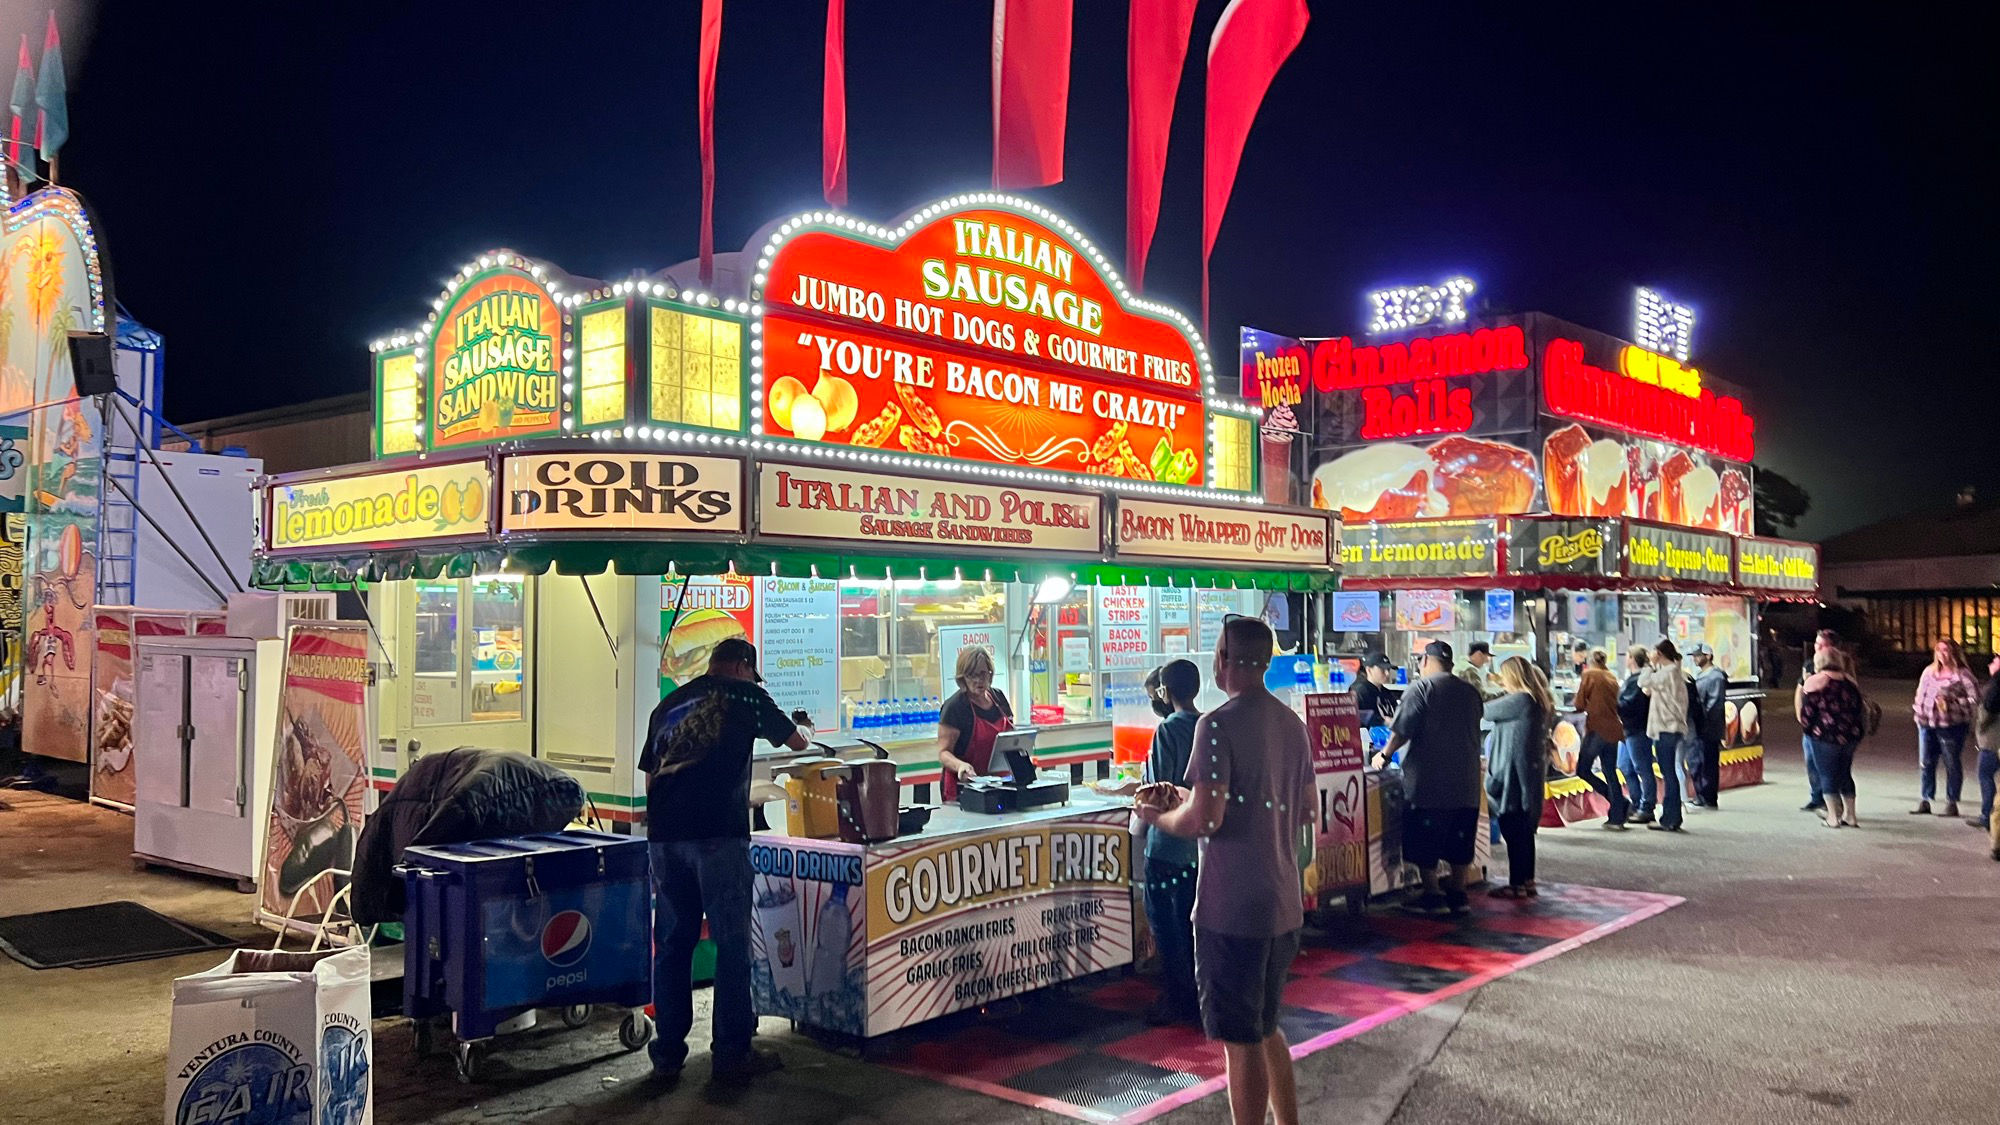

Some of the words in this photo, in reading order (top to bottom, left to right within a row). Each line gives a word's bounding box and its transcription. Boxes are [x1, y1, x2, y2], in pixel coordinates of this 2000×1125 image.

[952, 217, 1073, 285] ITALIAN
[921, 258, 1102, 338] SAUSAGE
[1371, 276, 1476, 332] HOT
[455, 294, 539, 346] ITALIAN
[791, 274, 885, 322] JUMBO
[894, 298, 945, 336] HOT
[952, 315, 1016, 351] DOGS
[1023, 328, 1041, 352] &
[1047, 333, 1138, 376] GOURMET
[1143, 352, 1192, 386] FRIES
[444, 333, 550, 390] SAUSAGE
[1255, 351, 1300, 379] Frozen
[1312, 325, 1530, 393] Cinnamon
[438, 371, 557, 426] SANDWICH
[946, 361, 1041, 406] BACON
[1048, 381, 1084, 415] ME
[1259, 378, 1301, 409] Mocha
[1361, 379, 1473, 440] Rolls
[536, 460, 699, 490] COLD
[276, 474, 439, 545] lemonade
[289, 487, 330, 510] Fresh
[510, 484, 732, 523] DRINKS
[775, 471, 919, 517] ITALIAN
[929, 492, 991, 522] AND
[999, 490, 1091, 530] POLISH
[860, 515, 934, 539] SAUSAGE
[937, 522, 1033, 544] SANDWICHES
[1121, 508, 1174, 543] BACON
[1178, 513, 1250, 546] WRAPPED
[1255, 520, 1287, 553] HOT
[1291, 522, 1324, 550] DOGS
[1369, 535, 1485, 563] Lemonade
[1629, 536, 1659, 567] Coffee
[1665, 541, 1702, 575] Espresso
[1705, 546, 1729, 574] Cocoa
[802, 582, 806, 591] &
[1103, 597, 1145, 608] CHICKEN
[1111, 586, 1137, 595] TASTY
[1108, 610, 1140, 621] STRIPS
[1109, 629, 1141, 640] BACON
[963, 633, 989, 645] BACON
[1103, 642, 1147, 653] WRAPPED
[1320, 788, 1328, 834] I
[750, 845, 793, 877] COLD
[796, 849, 862, 886] DRINKS
[885, 834, 1042, 923] GOURMET
[1049, 832, 1121, 883] FRIES
[1317, 842, 1364, 885] BACON
[1041, 902, 1078, 927] FRENCH
[1079, 898, 1104, 919] FRIES
[900, 935, 942, 957] BACON
[944, 923, 984, 949] RANCH
[986, 917, 1015, 939] FRIES
[1011, 939, 1037, 960] CHILI
[1039, 931, 1074, 953] CHEESE
[1075, 925, 1100, 945] FRIES
[546, 968, 587, 991] pepsi
[906, 958, 950, 985] GARLIC
[952, 951, 983, 973] FRIES
[955, 977, 995, 1000] BACON
[997, 968, 1032, 990] CHEESE
[1035, 960, 1062, 982] FRIES
[324, 1012, 360, 1030] COUNTY
[178, 1031, 250, 1080] VENTURA
[254, 1029, 302, 1061] COUNTY
